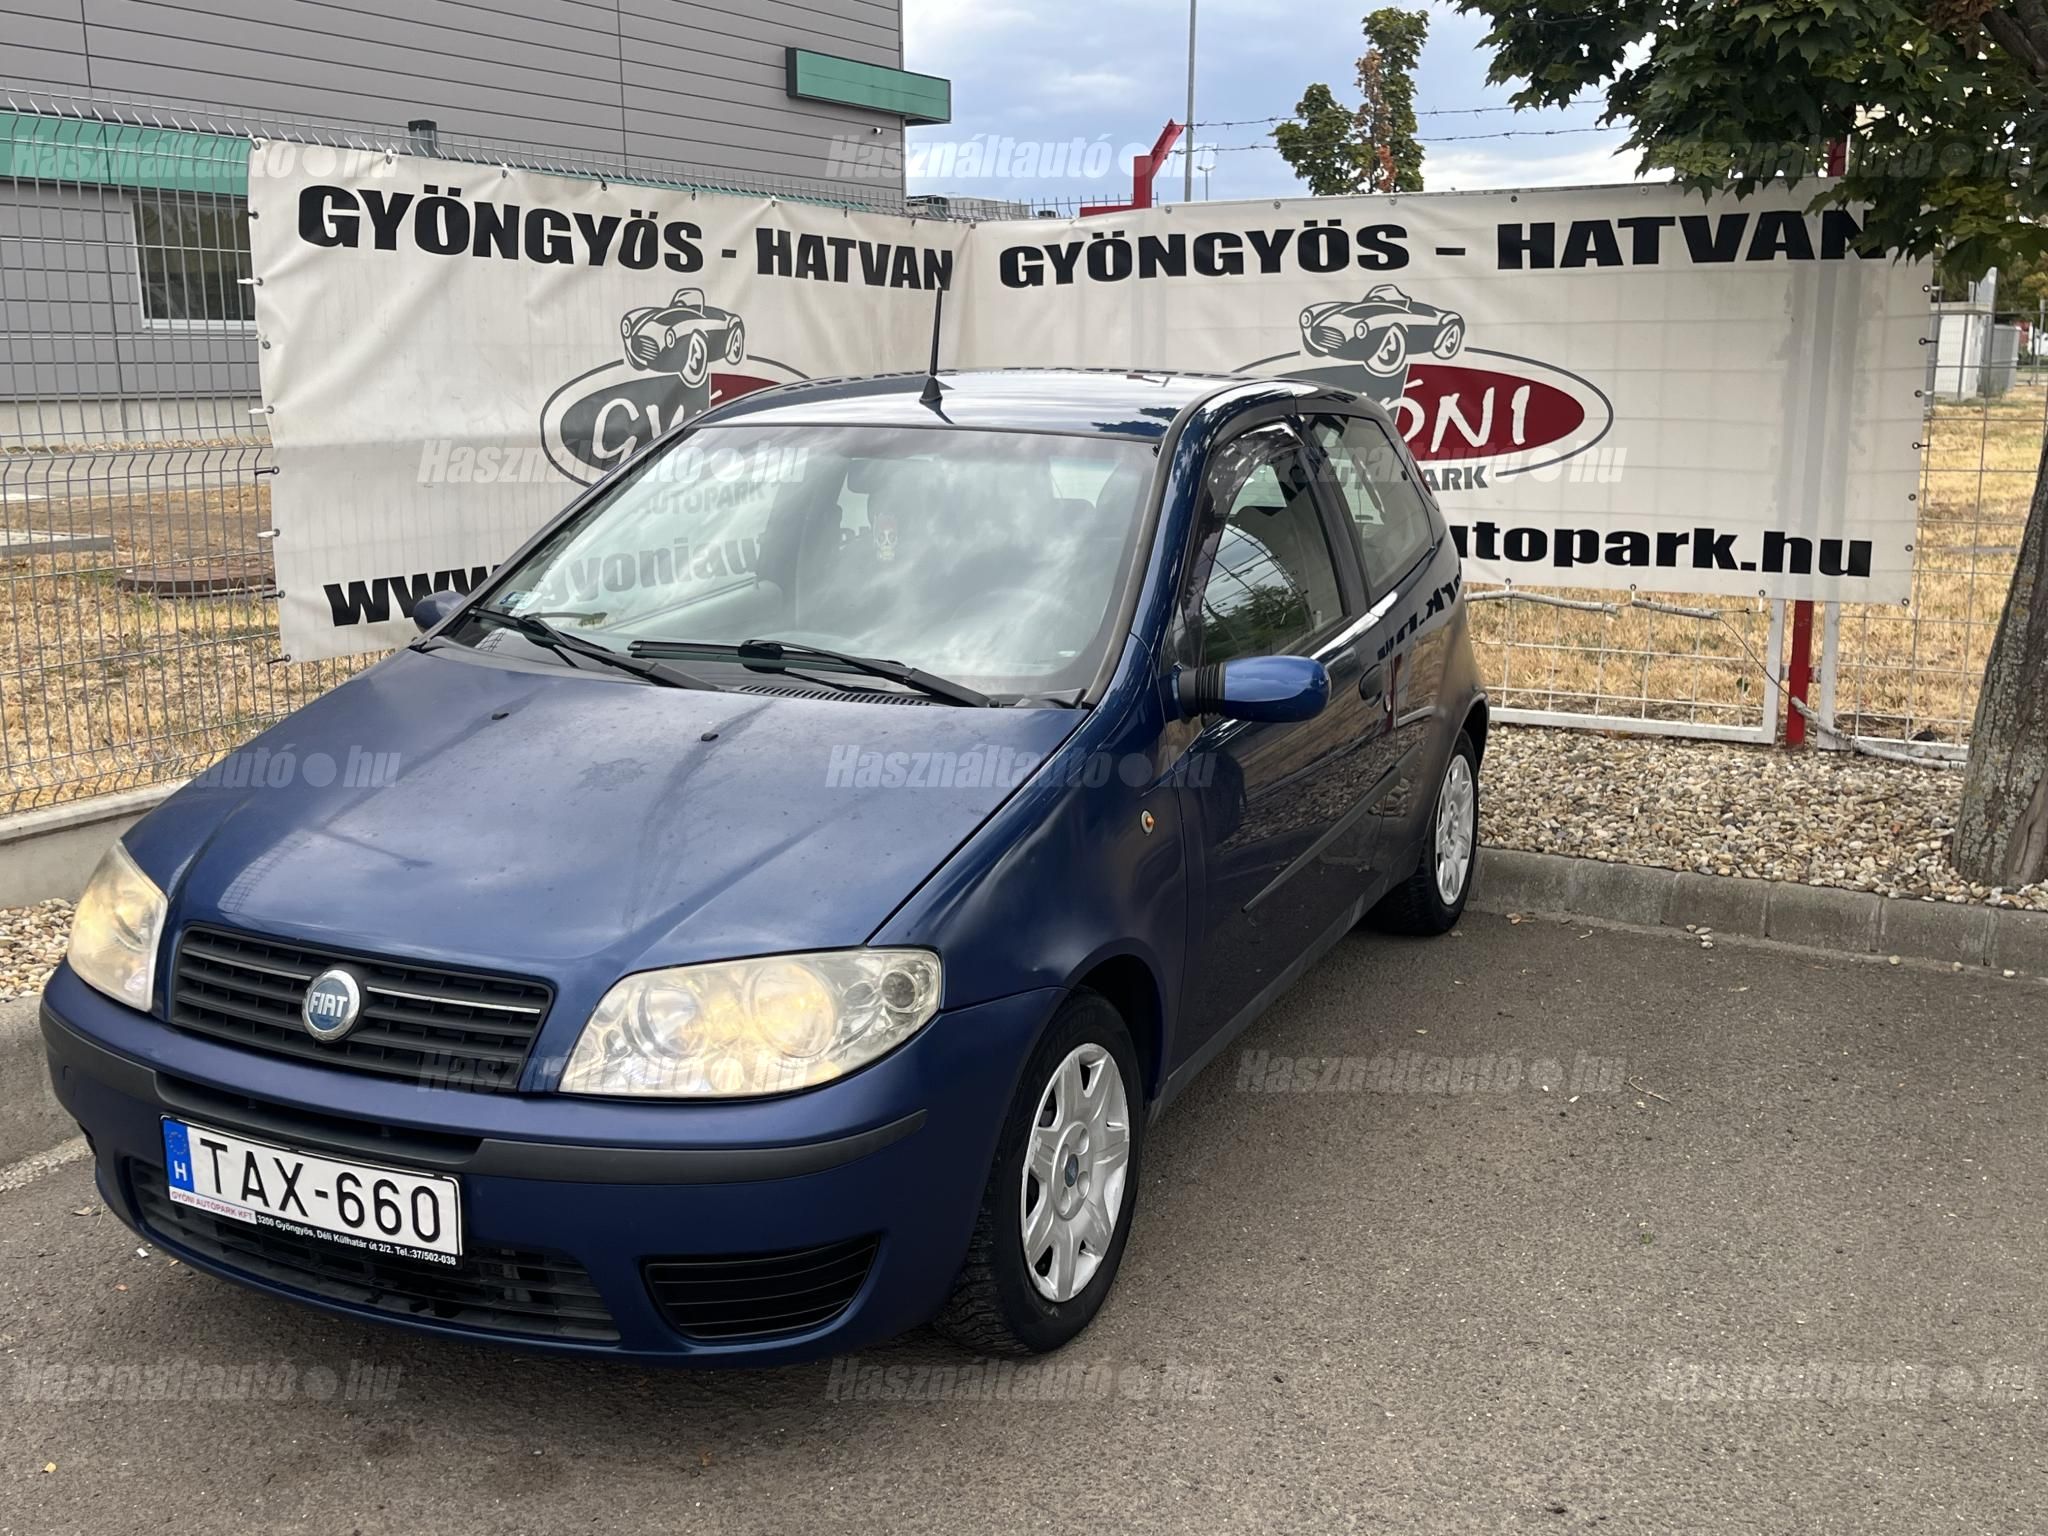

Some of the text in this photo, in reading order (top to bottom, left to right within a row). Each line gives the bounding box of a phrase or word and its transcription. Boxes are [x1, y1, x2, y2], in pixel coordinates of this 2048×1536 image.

[298, 184, 704, 273] GYÖNGYÖS
[755, 228, 954, 291] HATVAN
[999, 219, 1411, 289] GYÖNGYÖS
[1497, 210, 1887, 269] HATVAN
[310, 991, 348, 1018] FIAT
[199, 1138, 441, 1244] TAX-660
[256, 1215, 274, 1227] 3200
